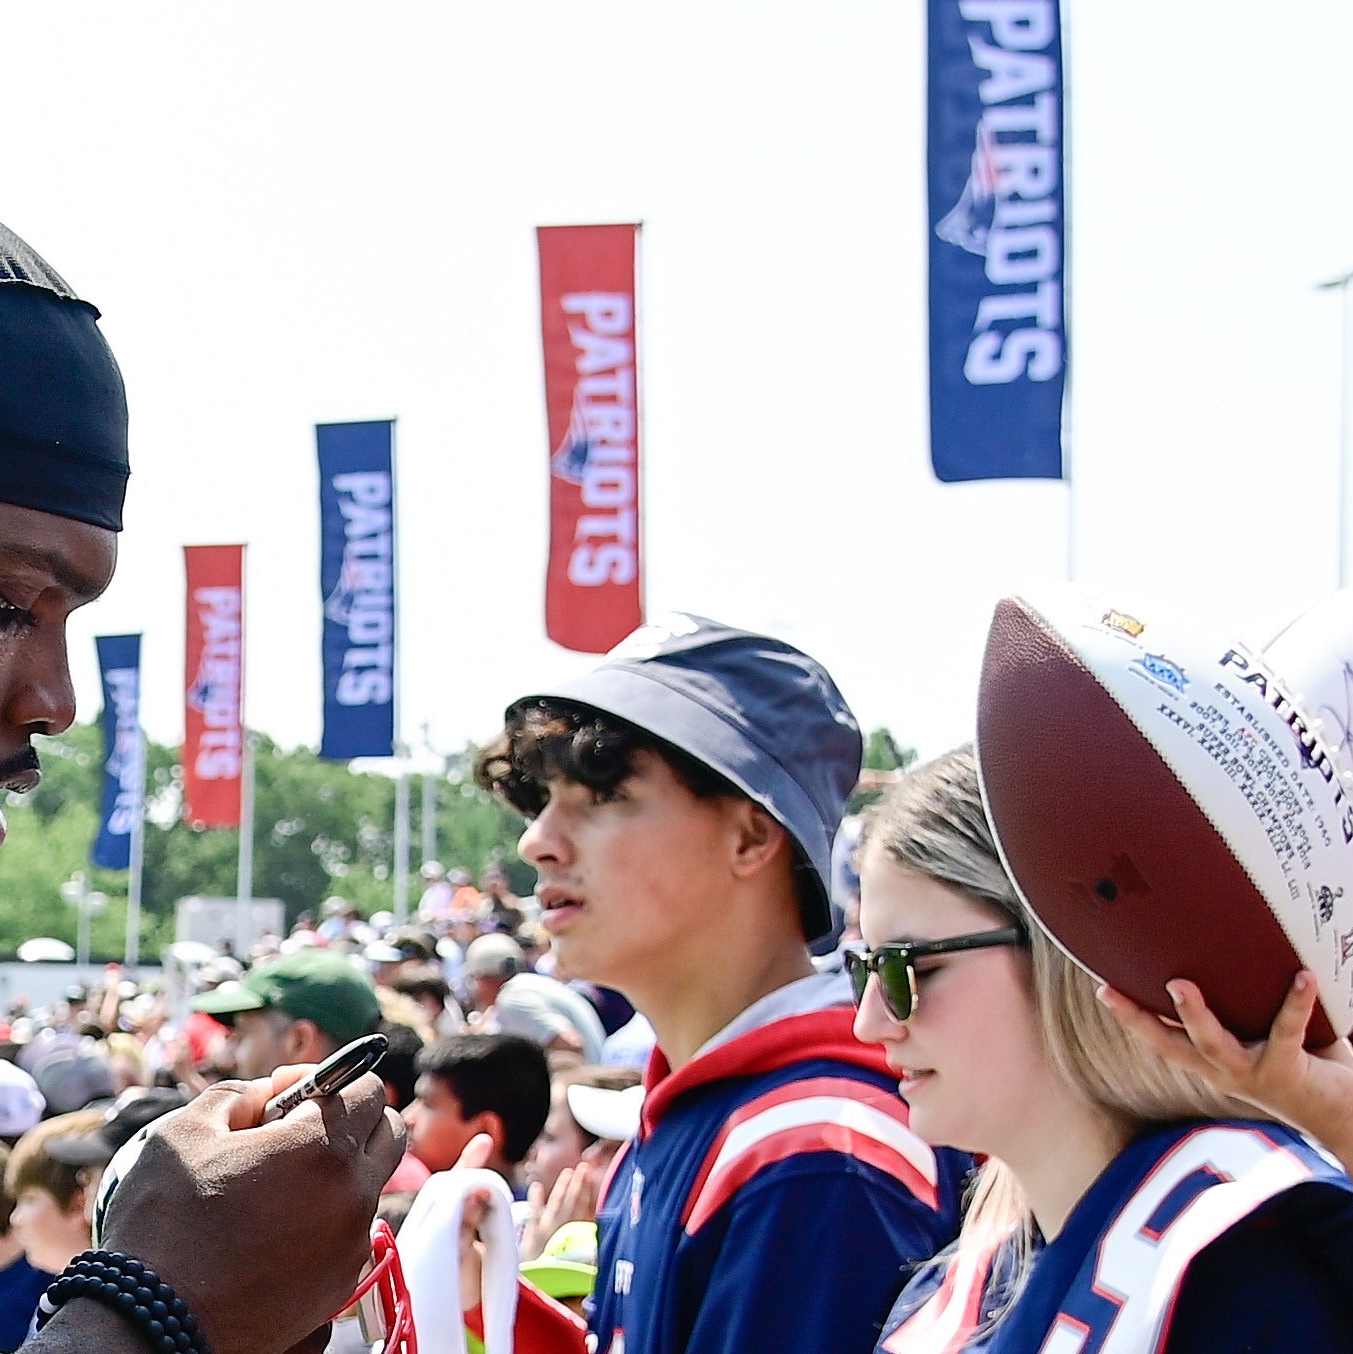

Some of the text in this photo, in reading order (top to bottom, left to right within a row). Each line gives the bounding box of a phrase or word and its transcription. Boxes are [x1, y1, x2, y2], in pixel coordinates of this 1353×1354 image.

[959, 0, 1063, 386] PATRIOTS
[559, 290, 637, 588] PATRIOTS
[193, 585, 242, 780] PATRIOTS
[332, 470, 393, 707] PATRIOTS
[1196, 722, 1295, 860] SUPER BOWL CHAMPIONS
[1214, 683, 1290, 768] ESTABLISHED
[1218, 648, 1353, 845] PATRIOTS
[1258, 748, 1303, 815] CHAMPIONS
